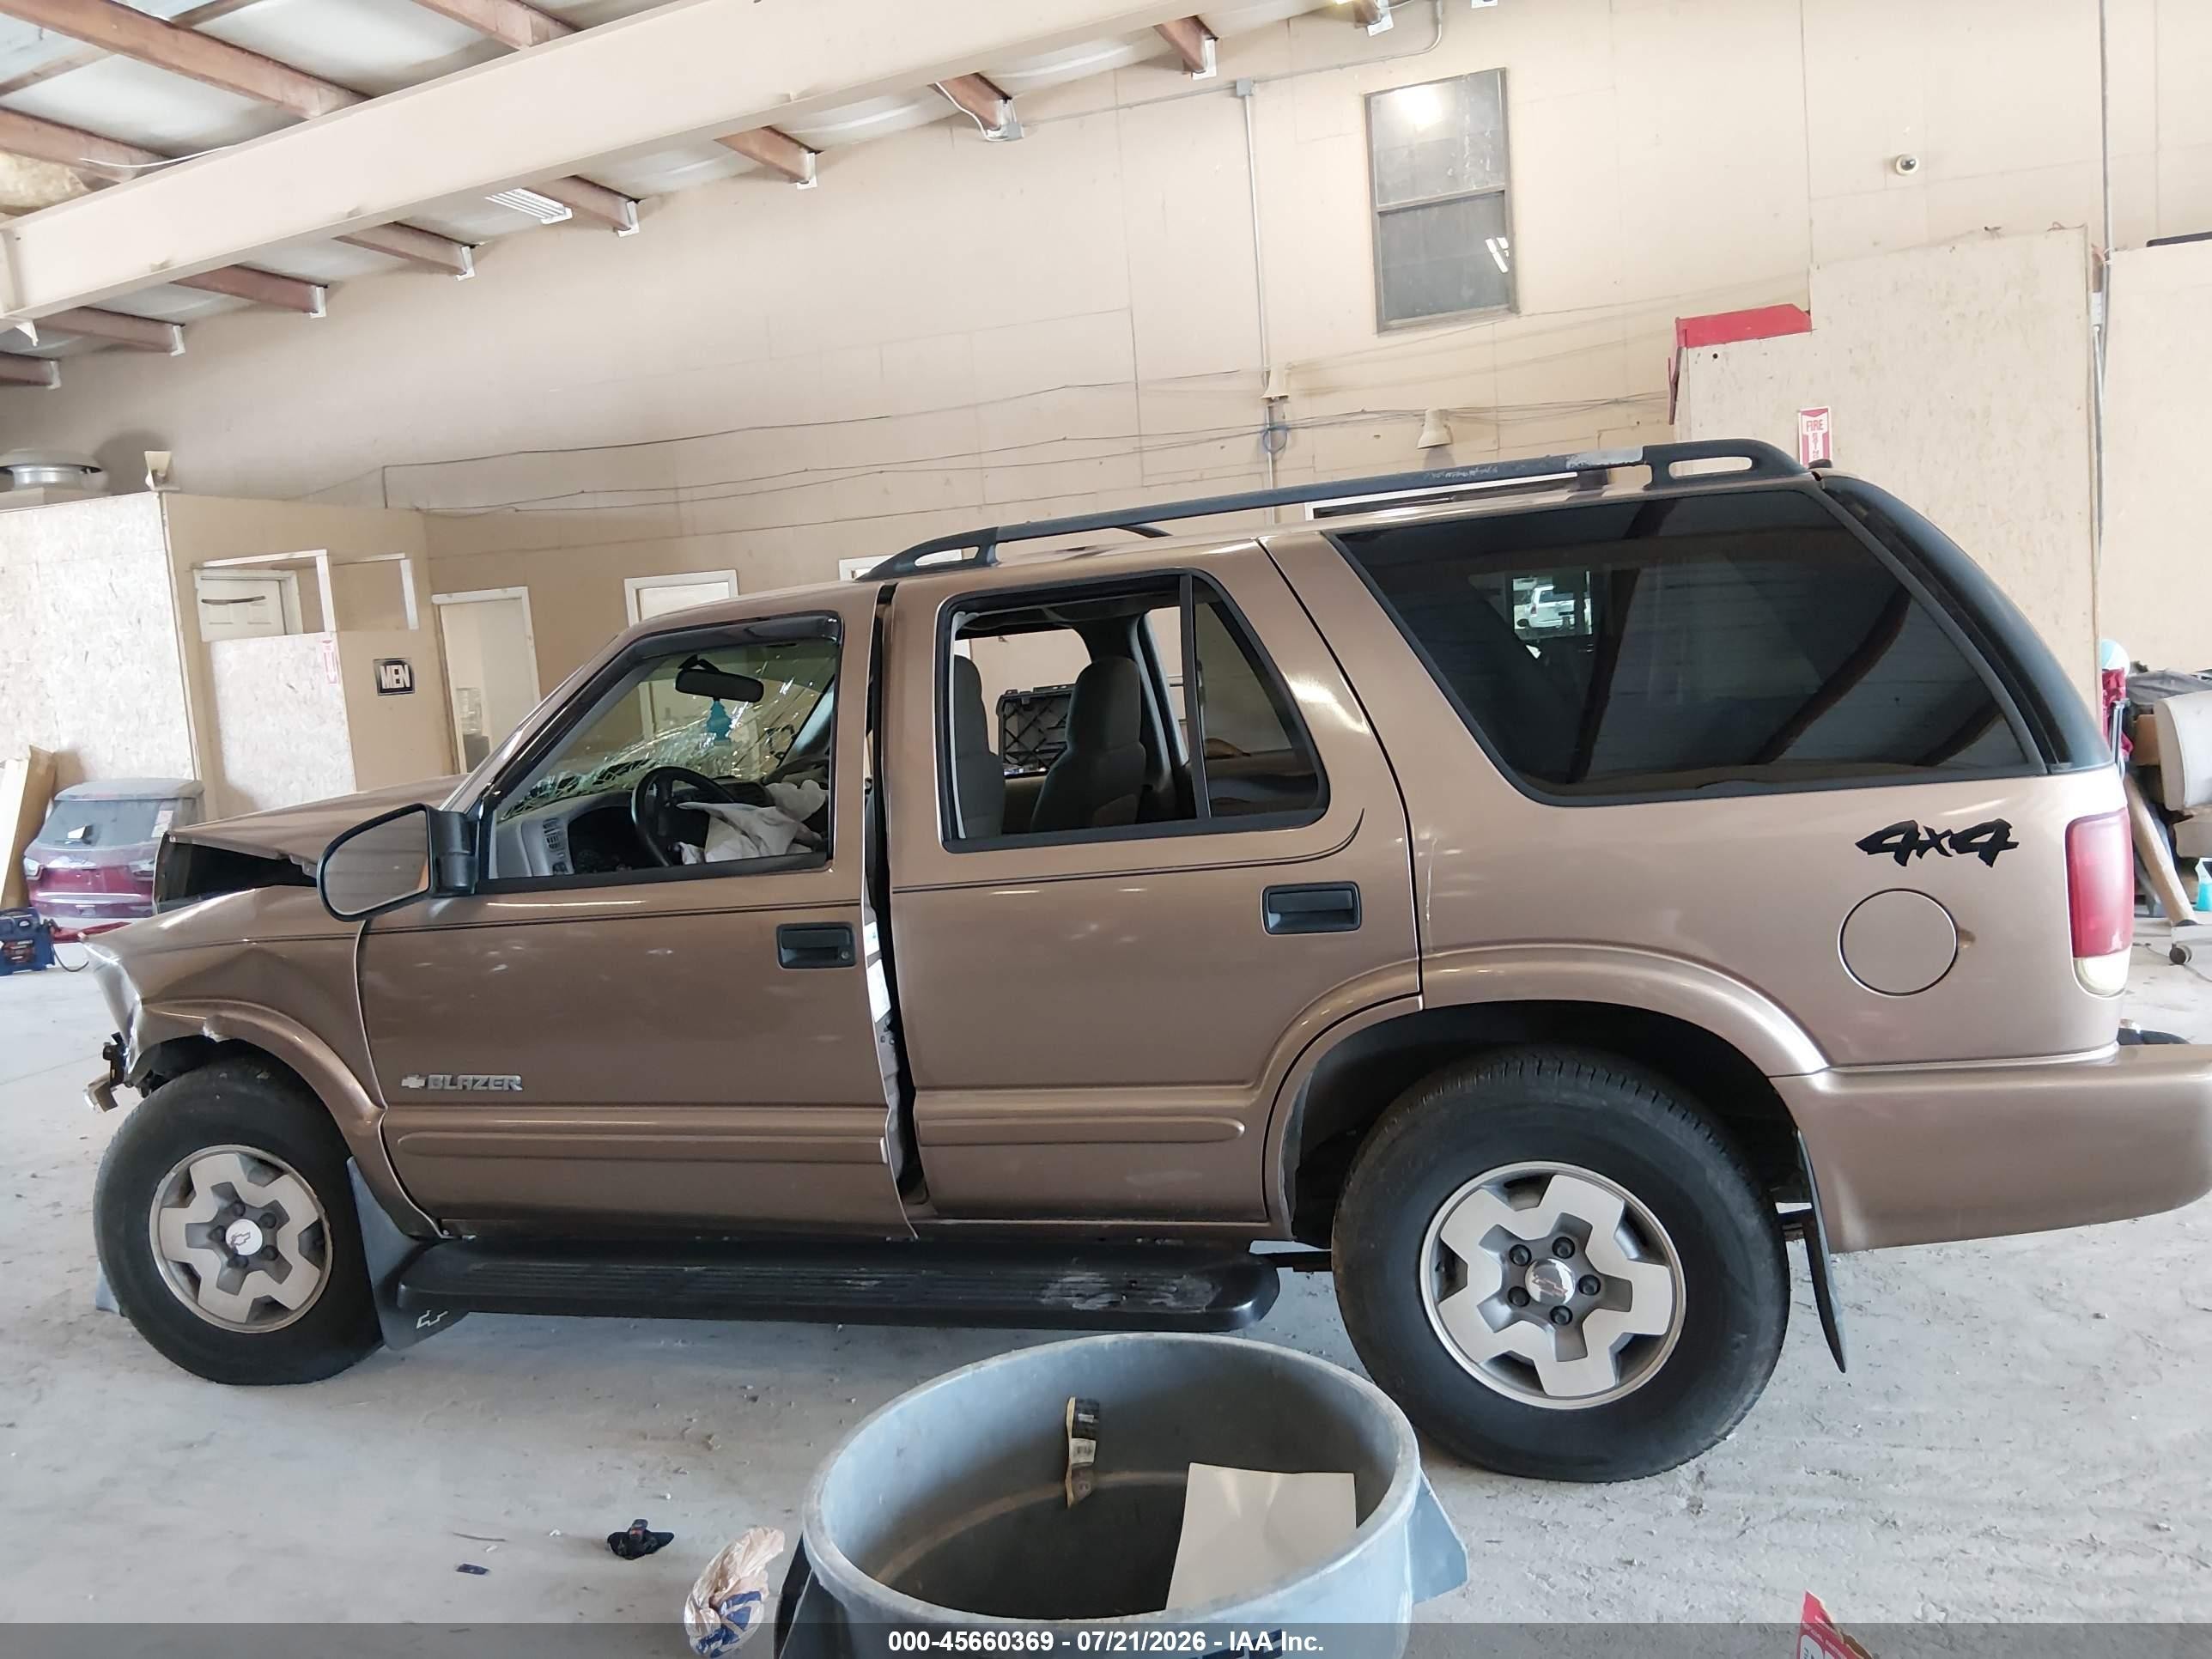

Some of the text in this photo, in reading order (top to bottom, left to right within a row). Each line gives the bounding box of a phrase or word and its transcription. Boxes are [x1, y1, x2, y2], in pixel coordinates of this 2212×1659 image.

[1806, 419, 1824, 432] FIRE
[380, 664, 410, 689] MEN
[1855, 818, 2020, 867] 4x4
[428, 1074, 523, 1091] BLAZER
